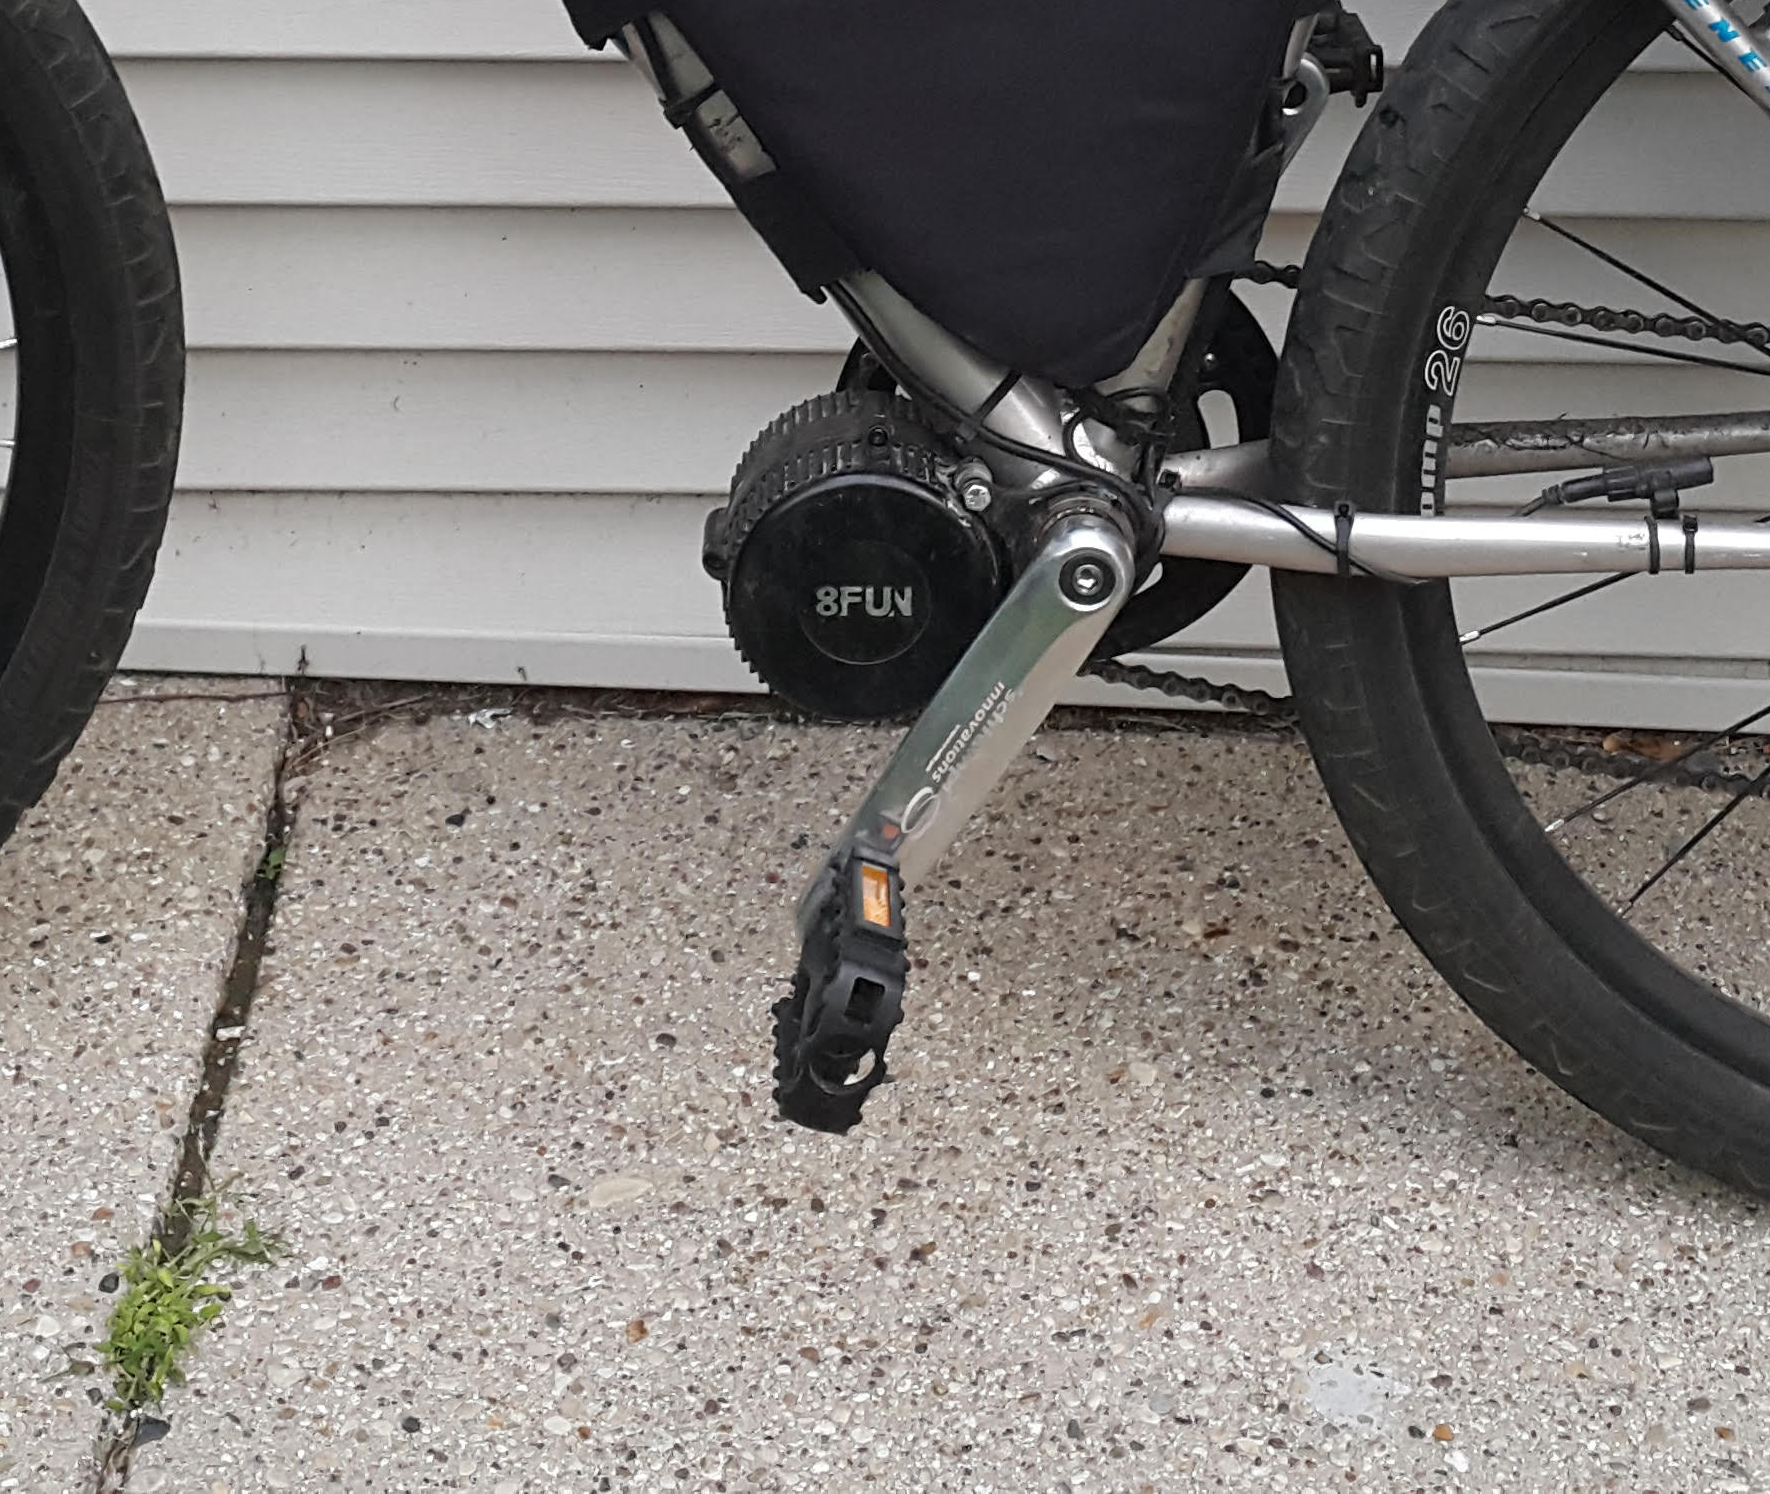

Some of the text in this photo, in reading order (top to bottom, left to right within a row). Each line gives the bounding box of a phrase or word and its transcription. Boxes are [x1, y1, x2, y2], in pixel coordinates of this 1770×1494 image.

[1424, 305, 1471, 397] 26
[815, 585, 913, 618] 8FUN
[931, 680, 1005, 784] innovations
